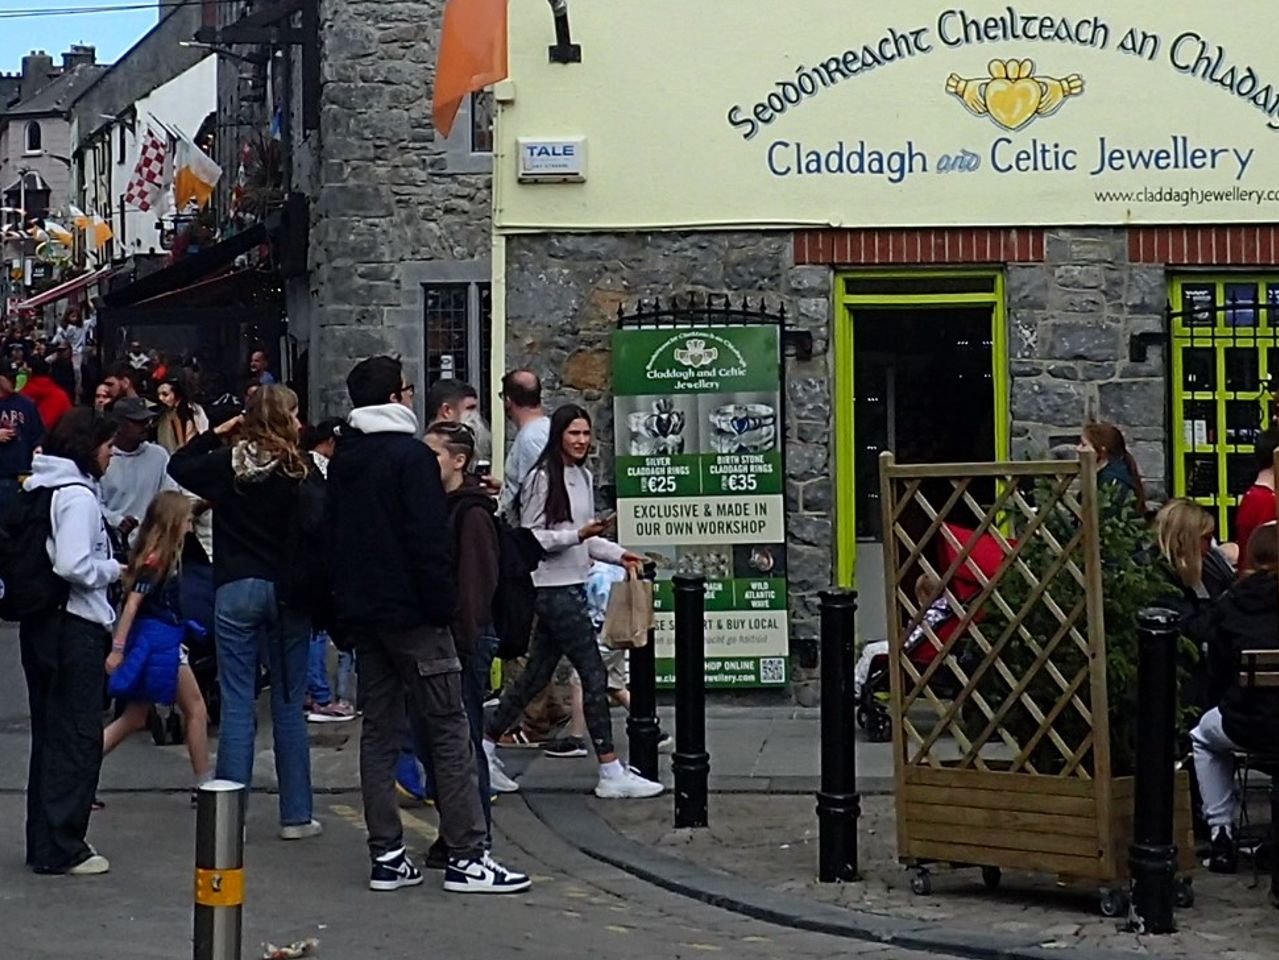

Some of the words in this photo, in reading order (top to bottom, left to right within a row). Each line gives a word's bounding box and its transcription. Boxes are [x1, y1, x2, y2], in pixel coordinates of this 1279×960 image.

[1118, 27, 1160, 60] an
[526, 145, 574, 157] TALE
[768, 140, 928, 184] Claddagh
[991, 137, 1077, 173] Celtic
[1090, 135, 1254, 180] Jewellery
[646, 368, 695, 380] Claddagh
[696, 368, 716, 377] and
[718, 366, 747, 377] Celtic
[674, 379, 719, 389] Jewellery
[645, 457, 671, 466] SILVER
[627, 466, 665, 476] CLADDAGH
[667, 466, 690, 476] RINGS
[709, 464, 748, 474] CLADDAGH
[750, 464, 773, 474] RINGS
[648, 476, 676, 493] €25
[728, 474, 757, 491] €35
[634, 504, 698, 519] EXCLUSIVE
[703, 503, 712, 517] &
[716, 503, 750, 517] MADE
[754, 502, 767, 516] IN
[636, 522, 661, 536] OUR
[665, 522, 693, 535] OWN
[697, 520, 766, 535] WORKSHOP
[726, 619, 746, 629] BUY
[748, 618, 778, 629] LOCAL
[703, 661, 722, 671] HOP
[724, 661, 754, 670] ONLINE
